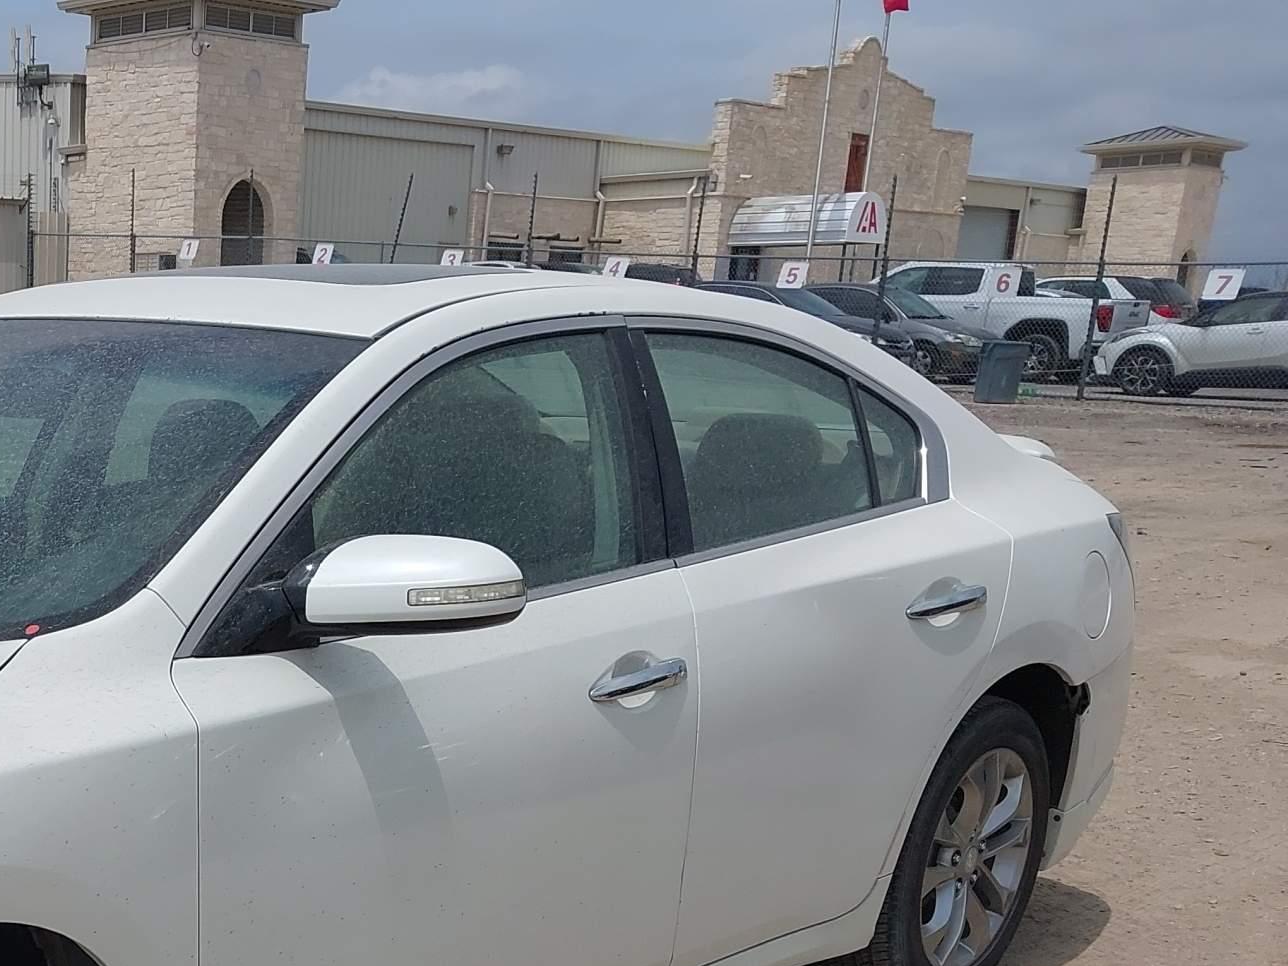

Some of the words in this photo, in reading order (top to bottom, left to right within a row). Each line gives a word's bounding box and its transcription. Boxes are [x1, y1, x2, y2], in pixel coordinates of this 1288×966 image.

[186, 241, 192, 256] 1
[317, 247, 328, 264] 2
[609, 261, 621, 277] 4
[786, 267, 800, 284] 5
[996, 273, 1011, 294] 6
[1216, 275, 1232, 294] 7
